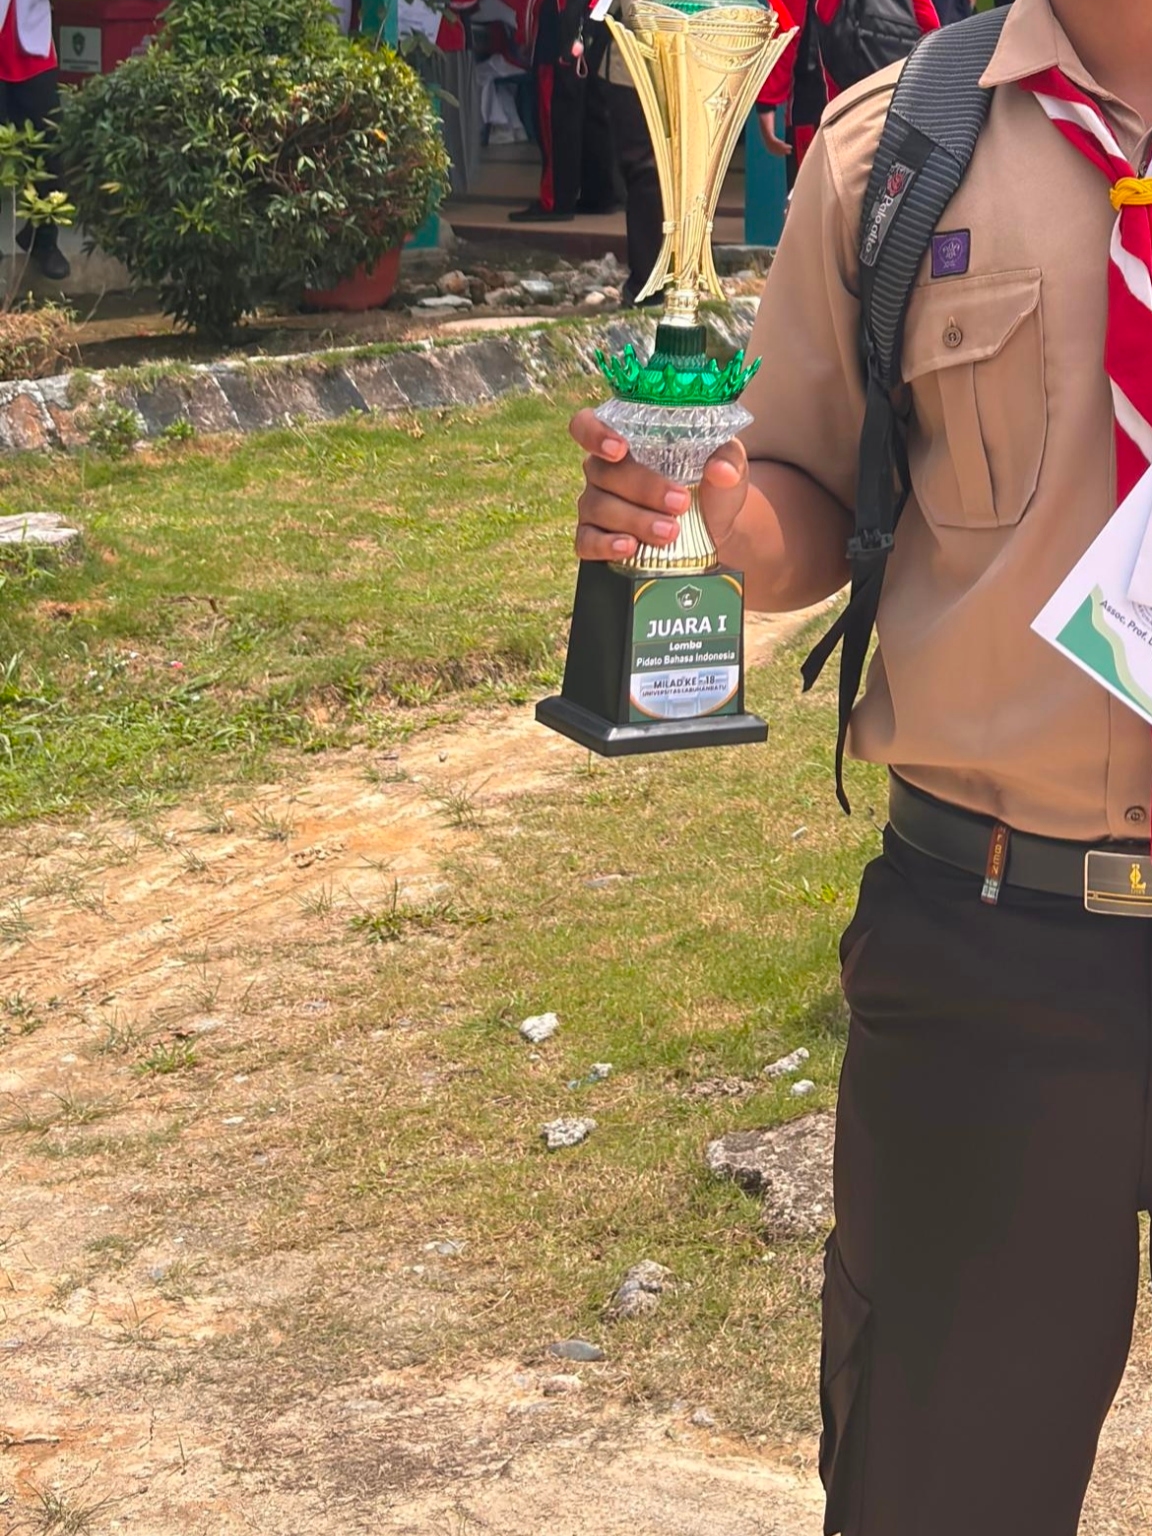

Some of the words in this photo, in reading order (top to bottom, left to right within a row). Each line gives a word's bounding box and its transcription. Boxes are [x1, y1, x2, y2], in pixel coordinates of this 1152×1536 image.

[646, 616, 712, 638] JUARA
[717, 614, 728, 632] I
[1099, 600, 1125, 624] Assoc.
[1127, 620, 1147, 641] Prof.
[669, 640, 702, 651] Lomba
[636, 657, 662, 667] Pidato
[664, 654, 693, 664] Bahasa
[695, 650, 735, 662] Indonesia
[653, 677, 683, 689] MILAD
[685, 676, 697, 686] KE
